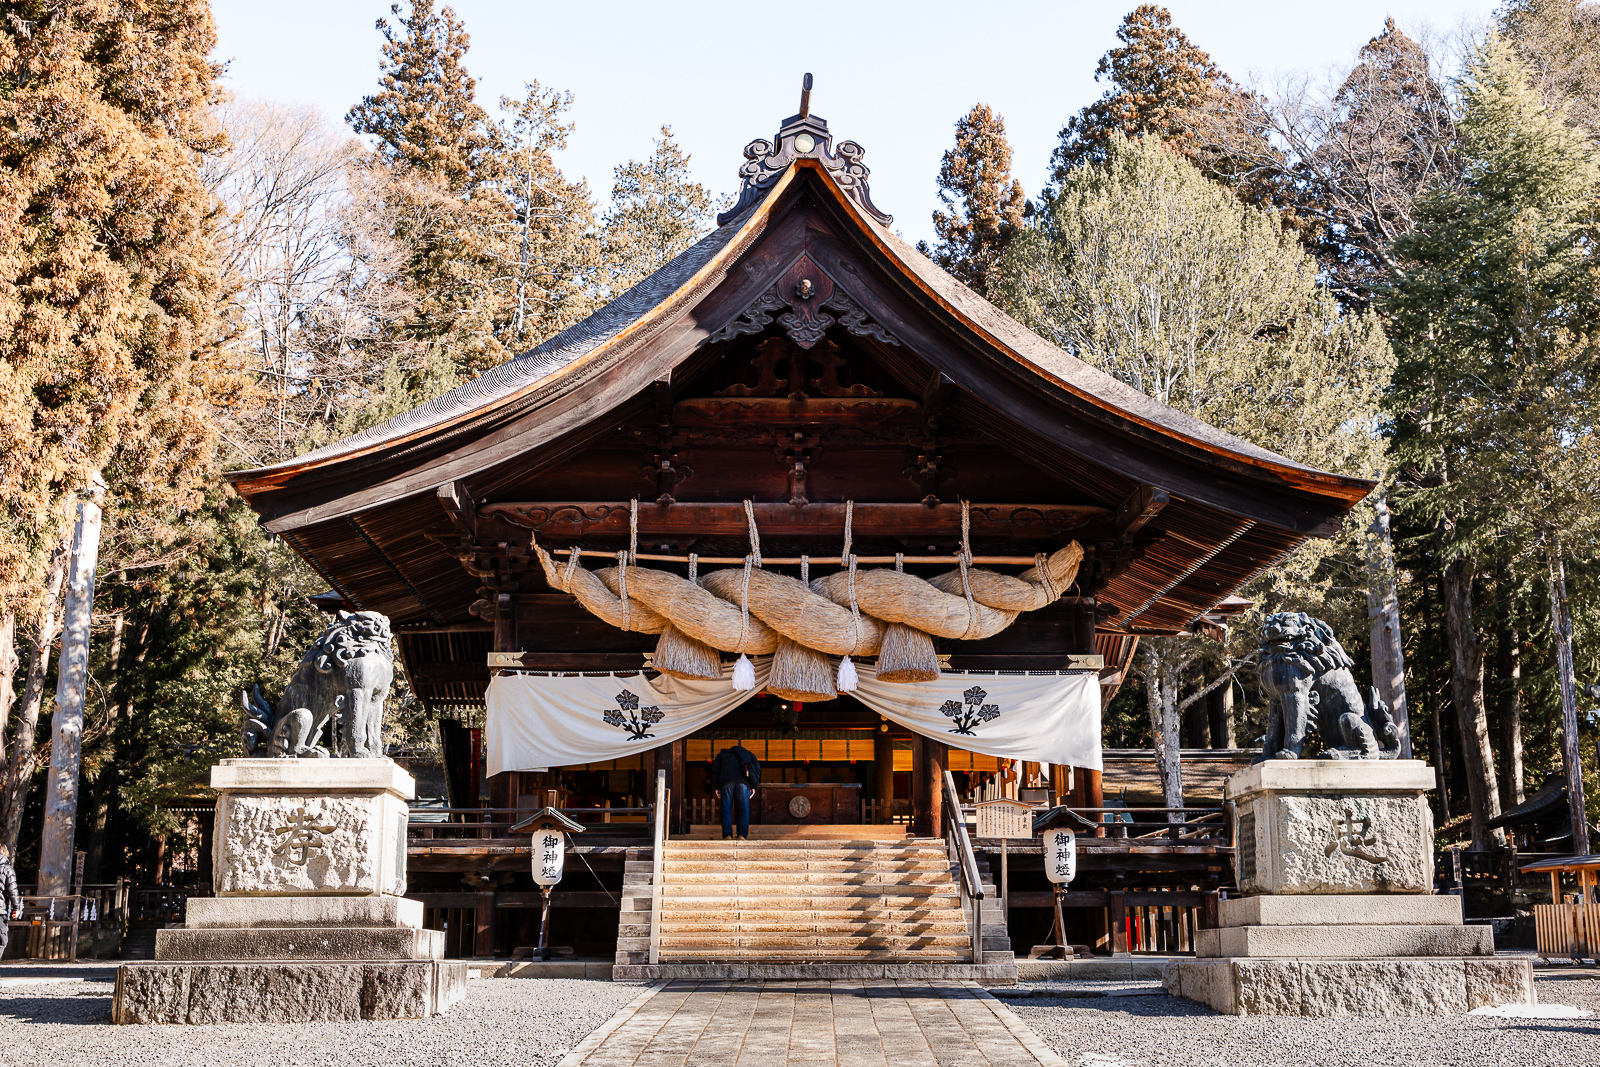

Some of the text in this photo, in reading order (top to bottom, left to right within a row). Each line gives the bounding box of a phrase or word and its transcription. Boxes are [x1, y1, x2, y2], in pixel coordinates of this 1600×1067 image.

[271, 806, 338, 866] 孝
[541, 834, 559, 879] 御神燈
[1054, 832, 1071, 877] 御神燈
[1324, 809, 1389, 865] 忠
